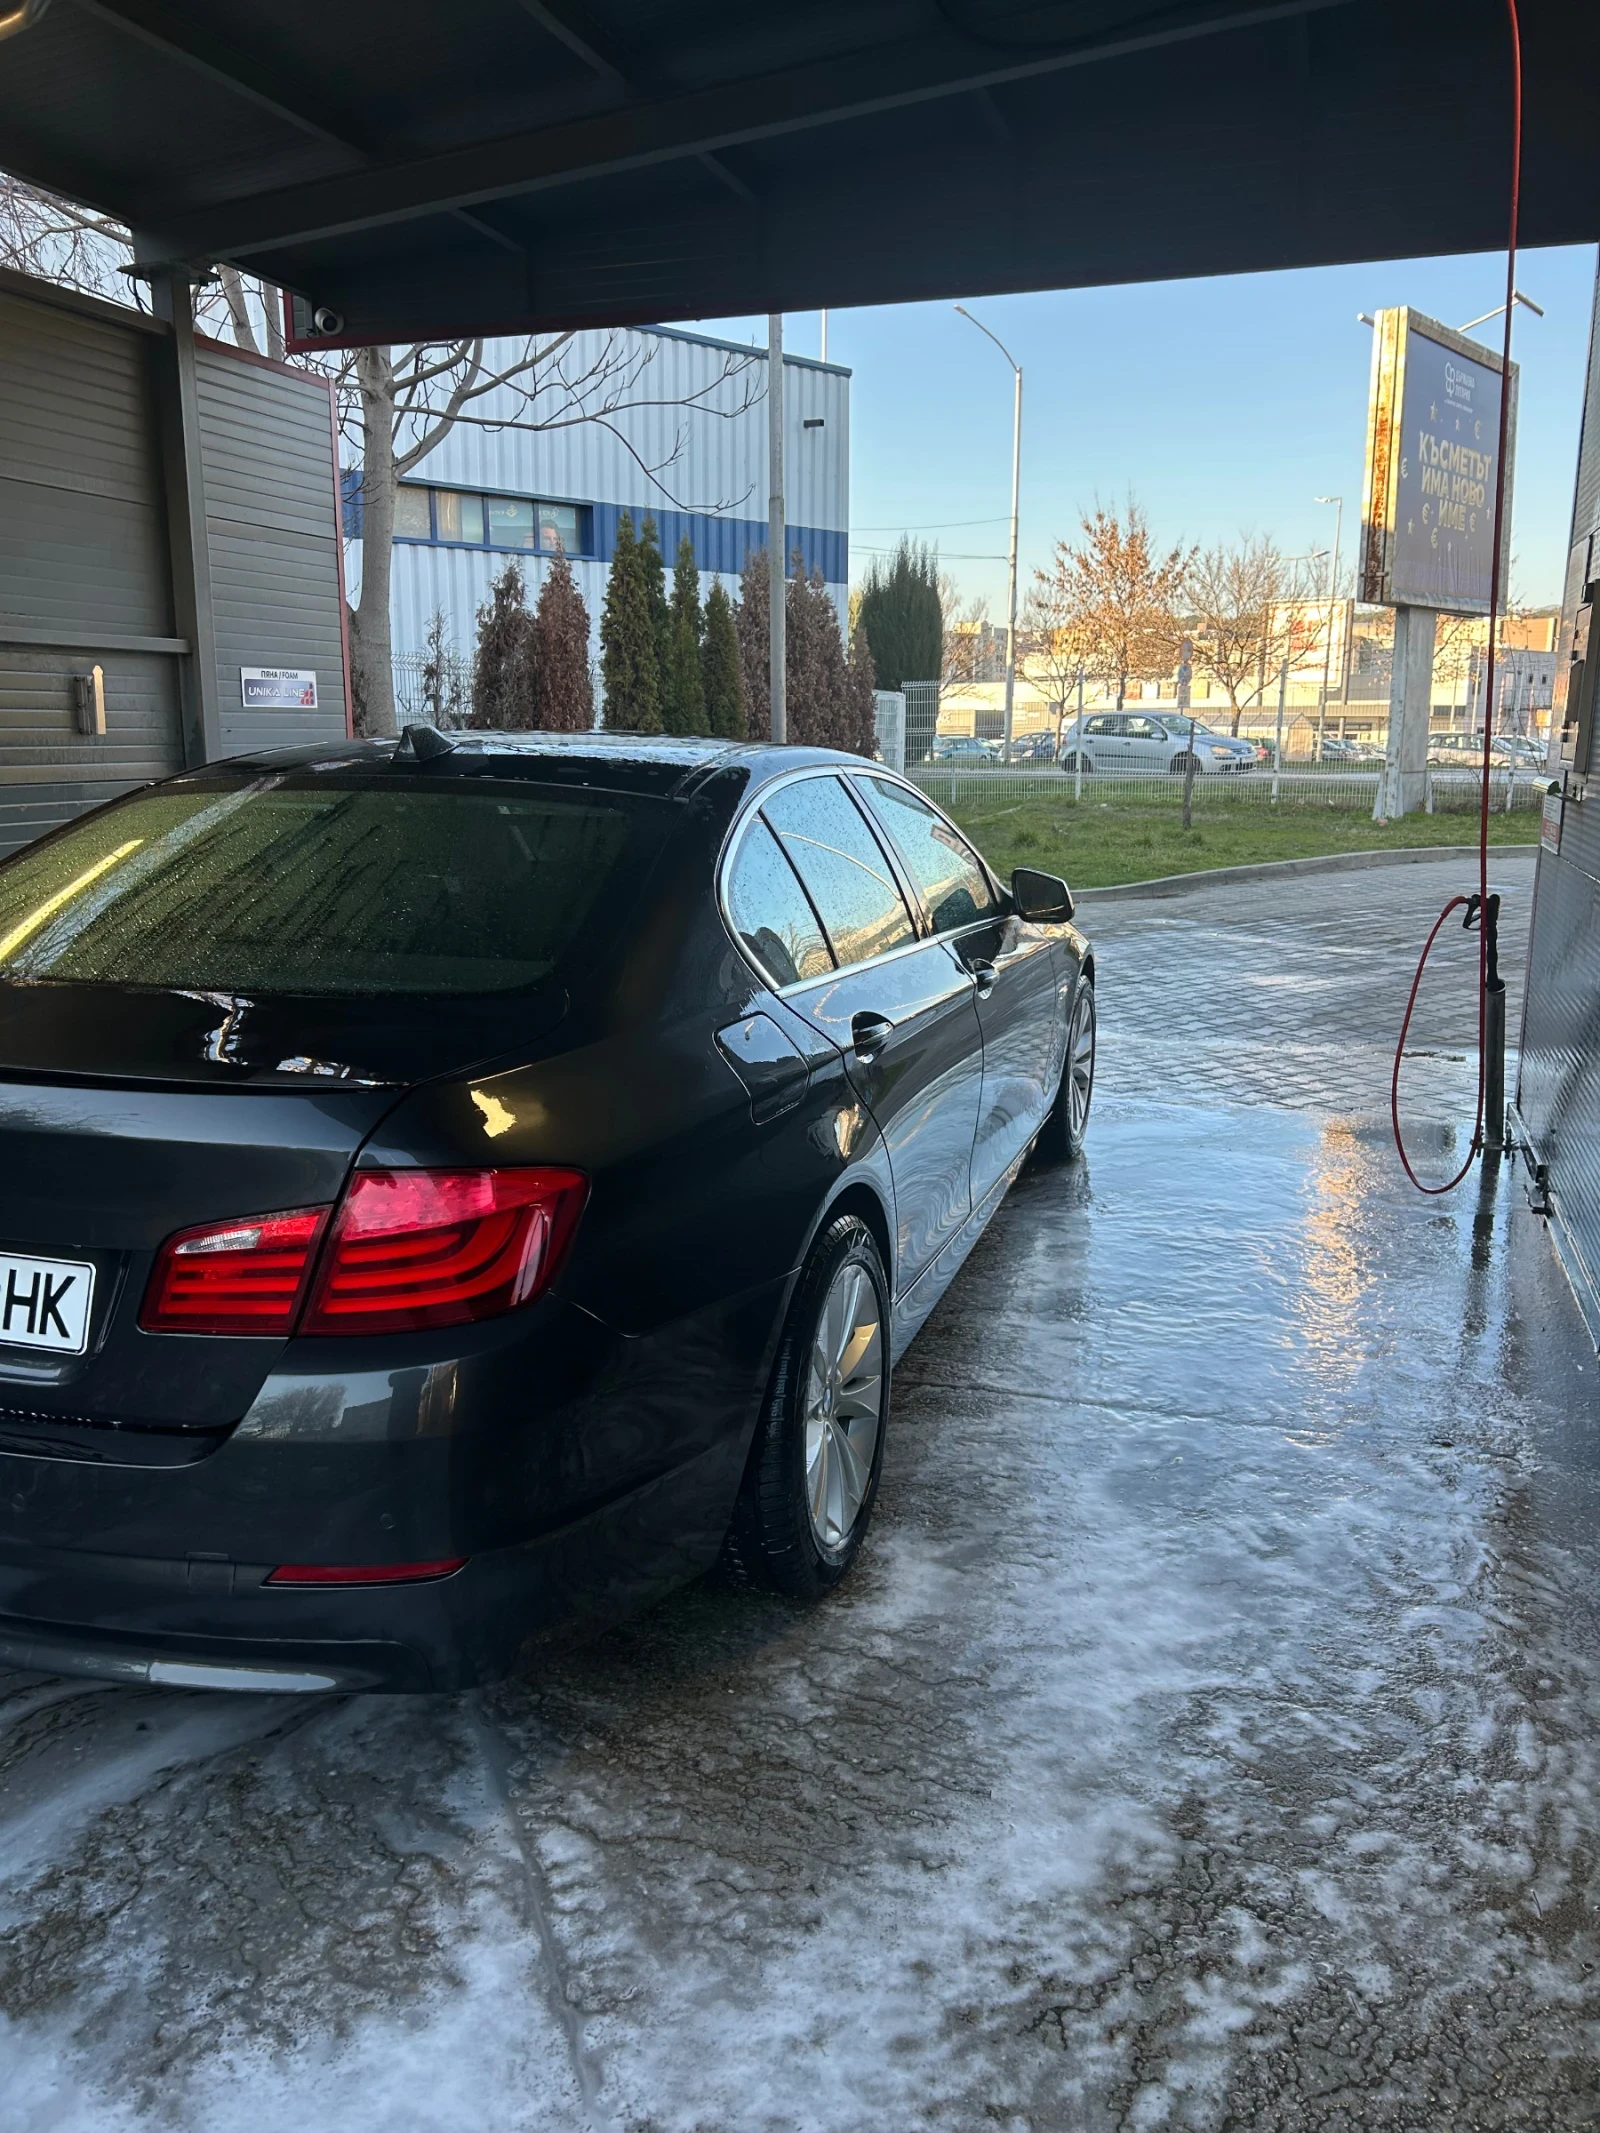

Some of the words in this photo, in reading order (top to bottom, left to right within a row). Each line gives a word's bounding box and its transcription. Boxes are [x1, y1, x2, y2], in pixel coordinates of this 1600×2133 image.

[1419, 430, 1492, 482] КЪСМЕТЪТ
[1421, 465, 1449, 499] ИМА
[1451, 475, 1485, 508] НОВО
[1438, 499, 1466, 531] ИМЕ
[248, 686, 281, 697] UNIKA
[283, 688, 305, 697] LINE
[261, 670, 278, 679] ПЯНА
[282, 671, 298, 679] FOAM
[2, 1268, 77, 1339] HK
